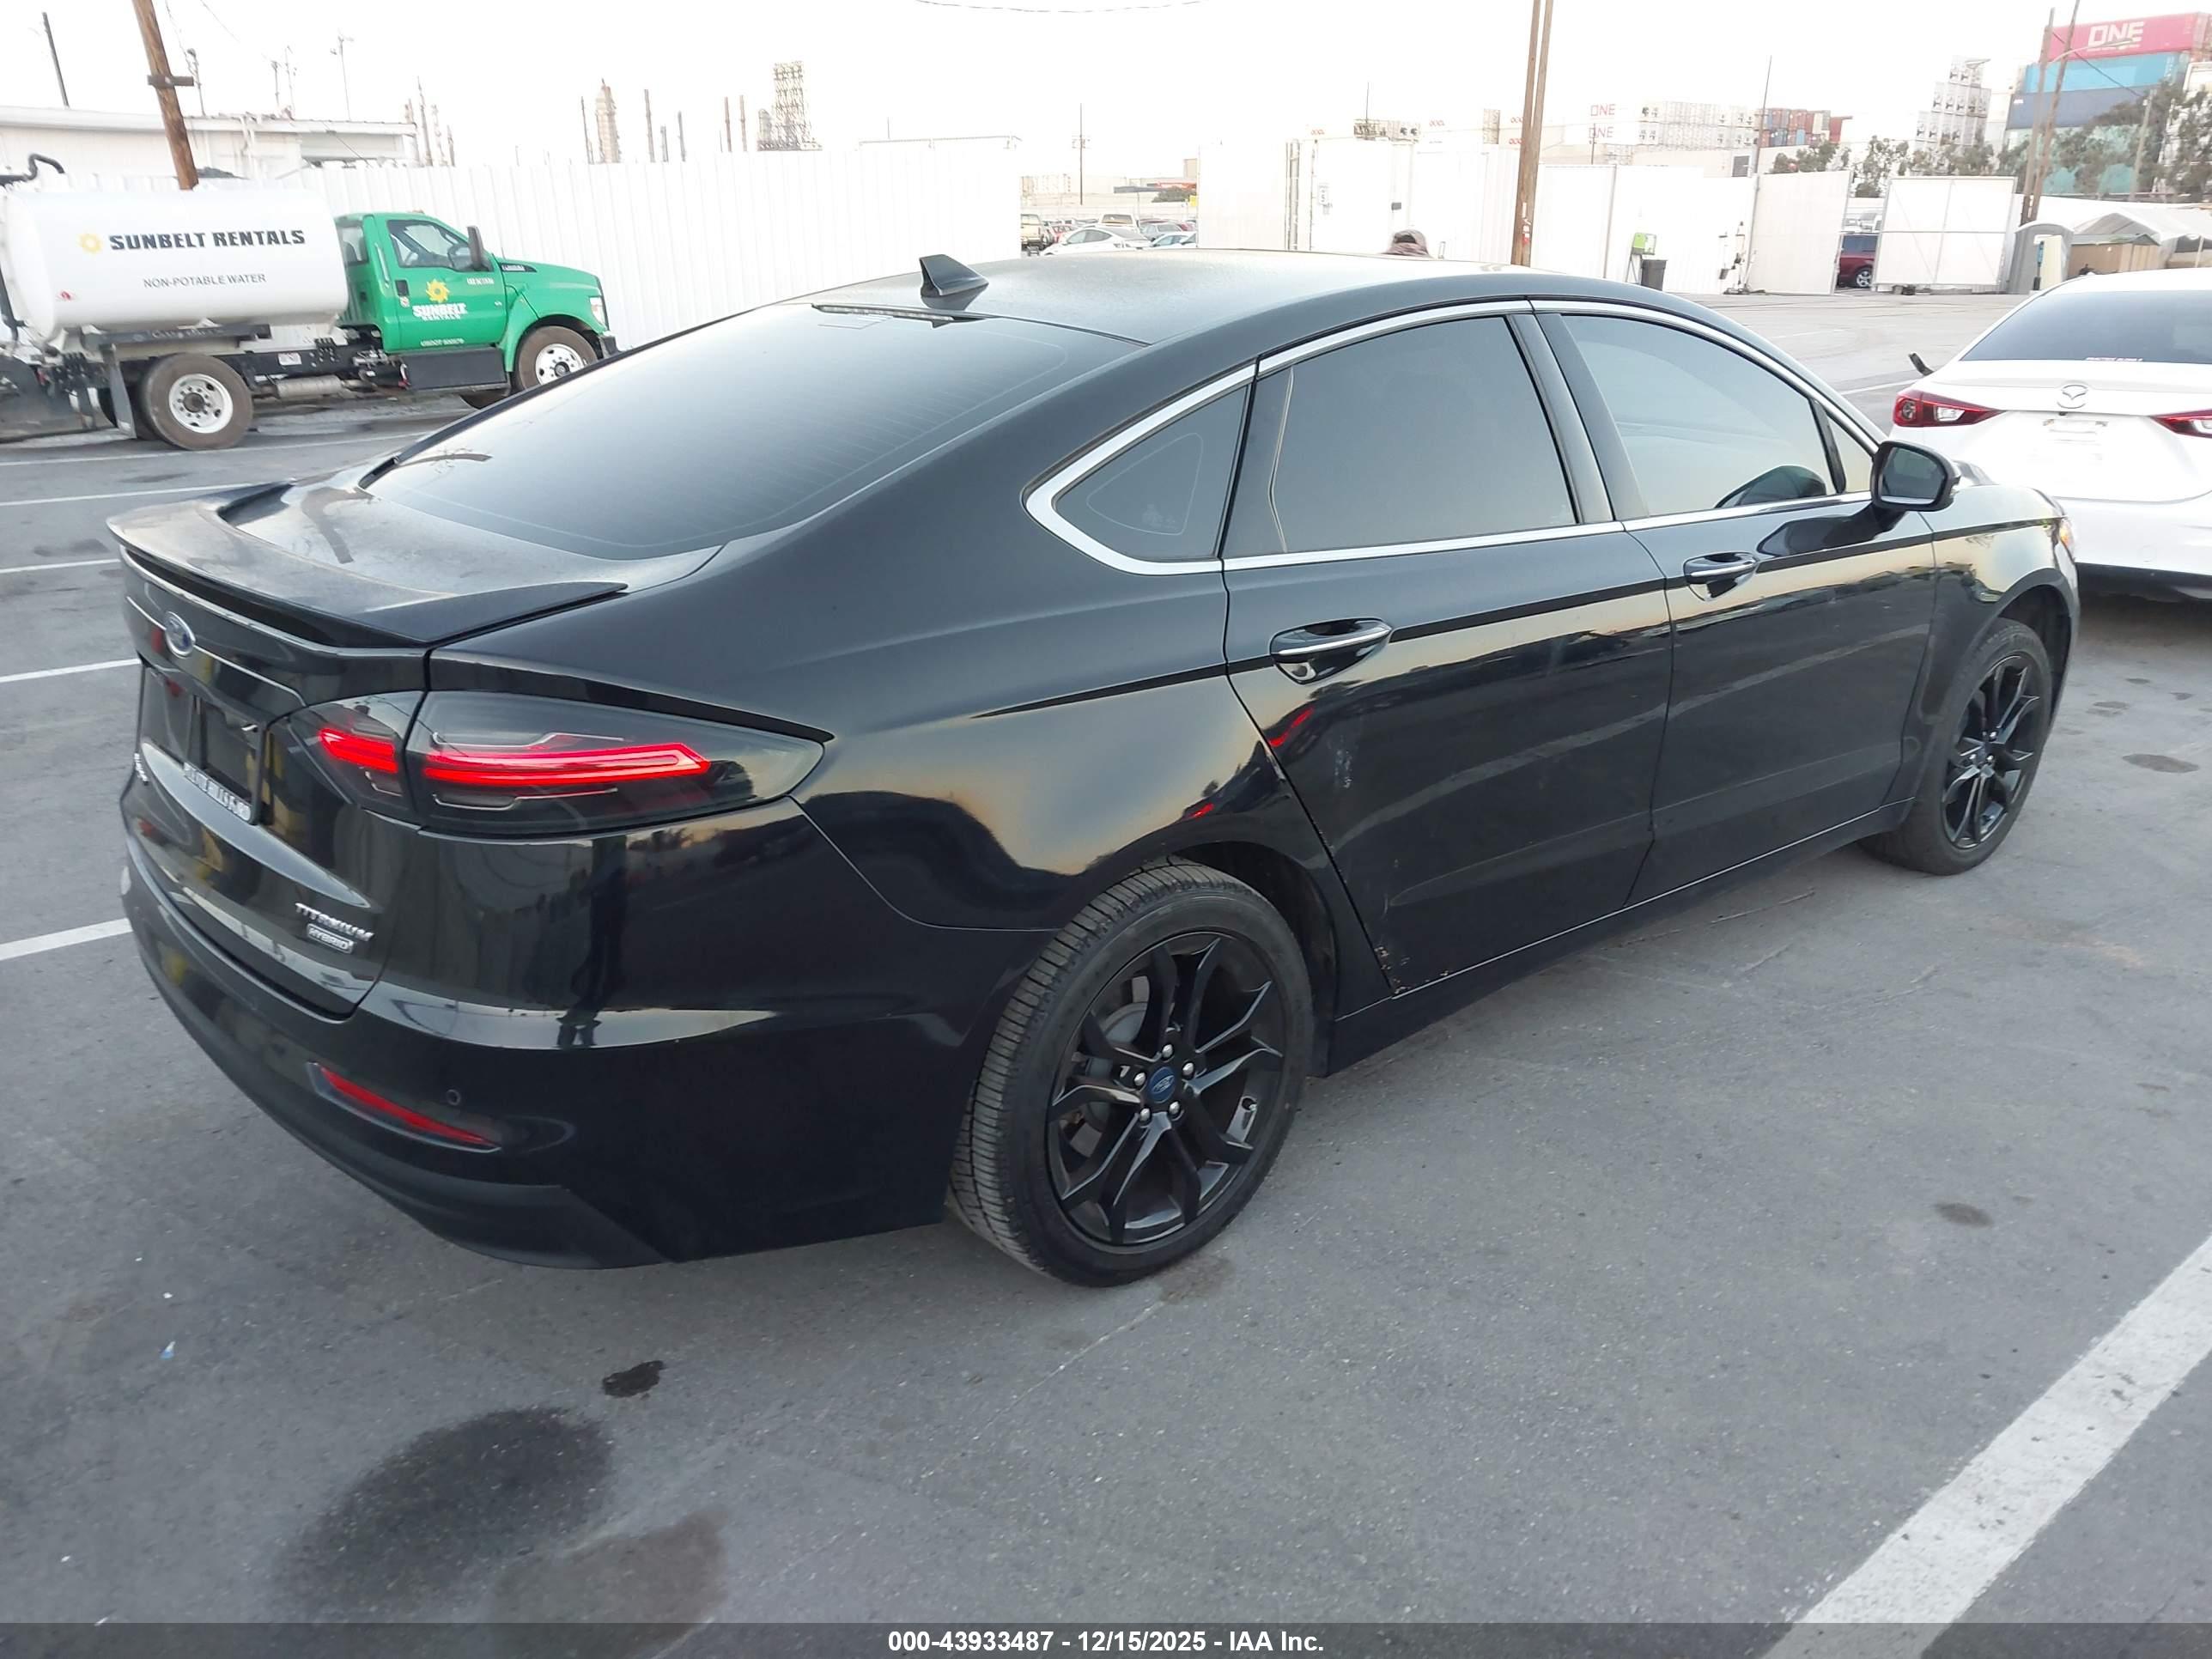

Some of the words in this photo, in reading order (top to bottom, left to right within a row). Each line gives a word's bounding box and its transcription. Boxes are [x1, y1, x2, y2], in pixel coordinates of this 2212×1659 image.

[2087, 21, 2146, 48] ONE
[1590, 103, 1616, 117] ONE
[109, 233, 205, 251] SUNBELT
[211, 229, 306, 246] RENTALS
[143, 276, 225, 289] NON-POTABLE
[227, 273, 267, 285] WATER
[412, 303, 468, 317] SUNBELT
[295, 902, 375, 941] TITANIUM
